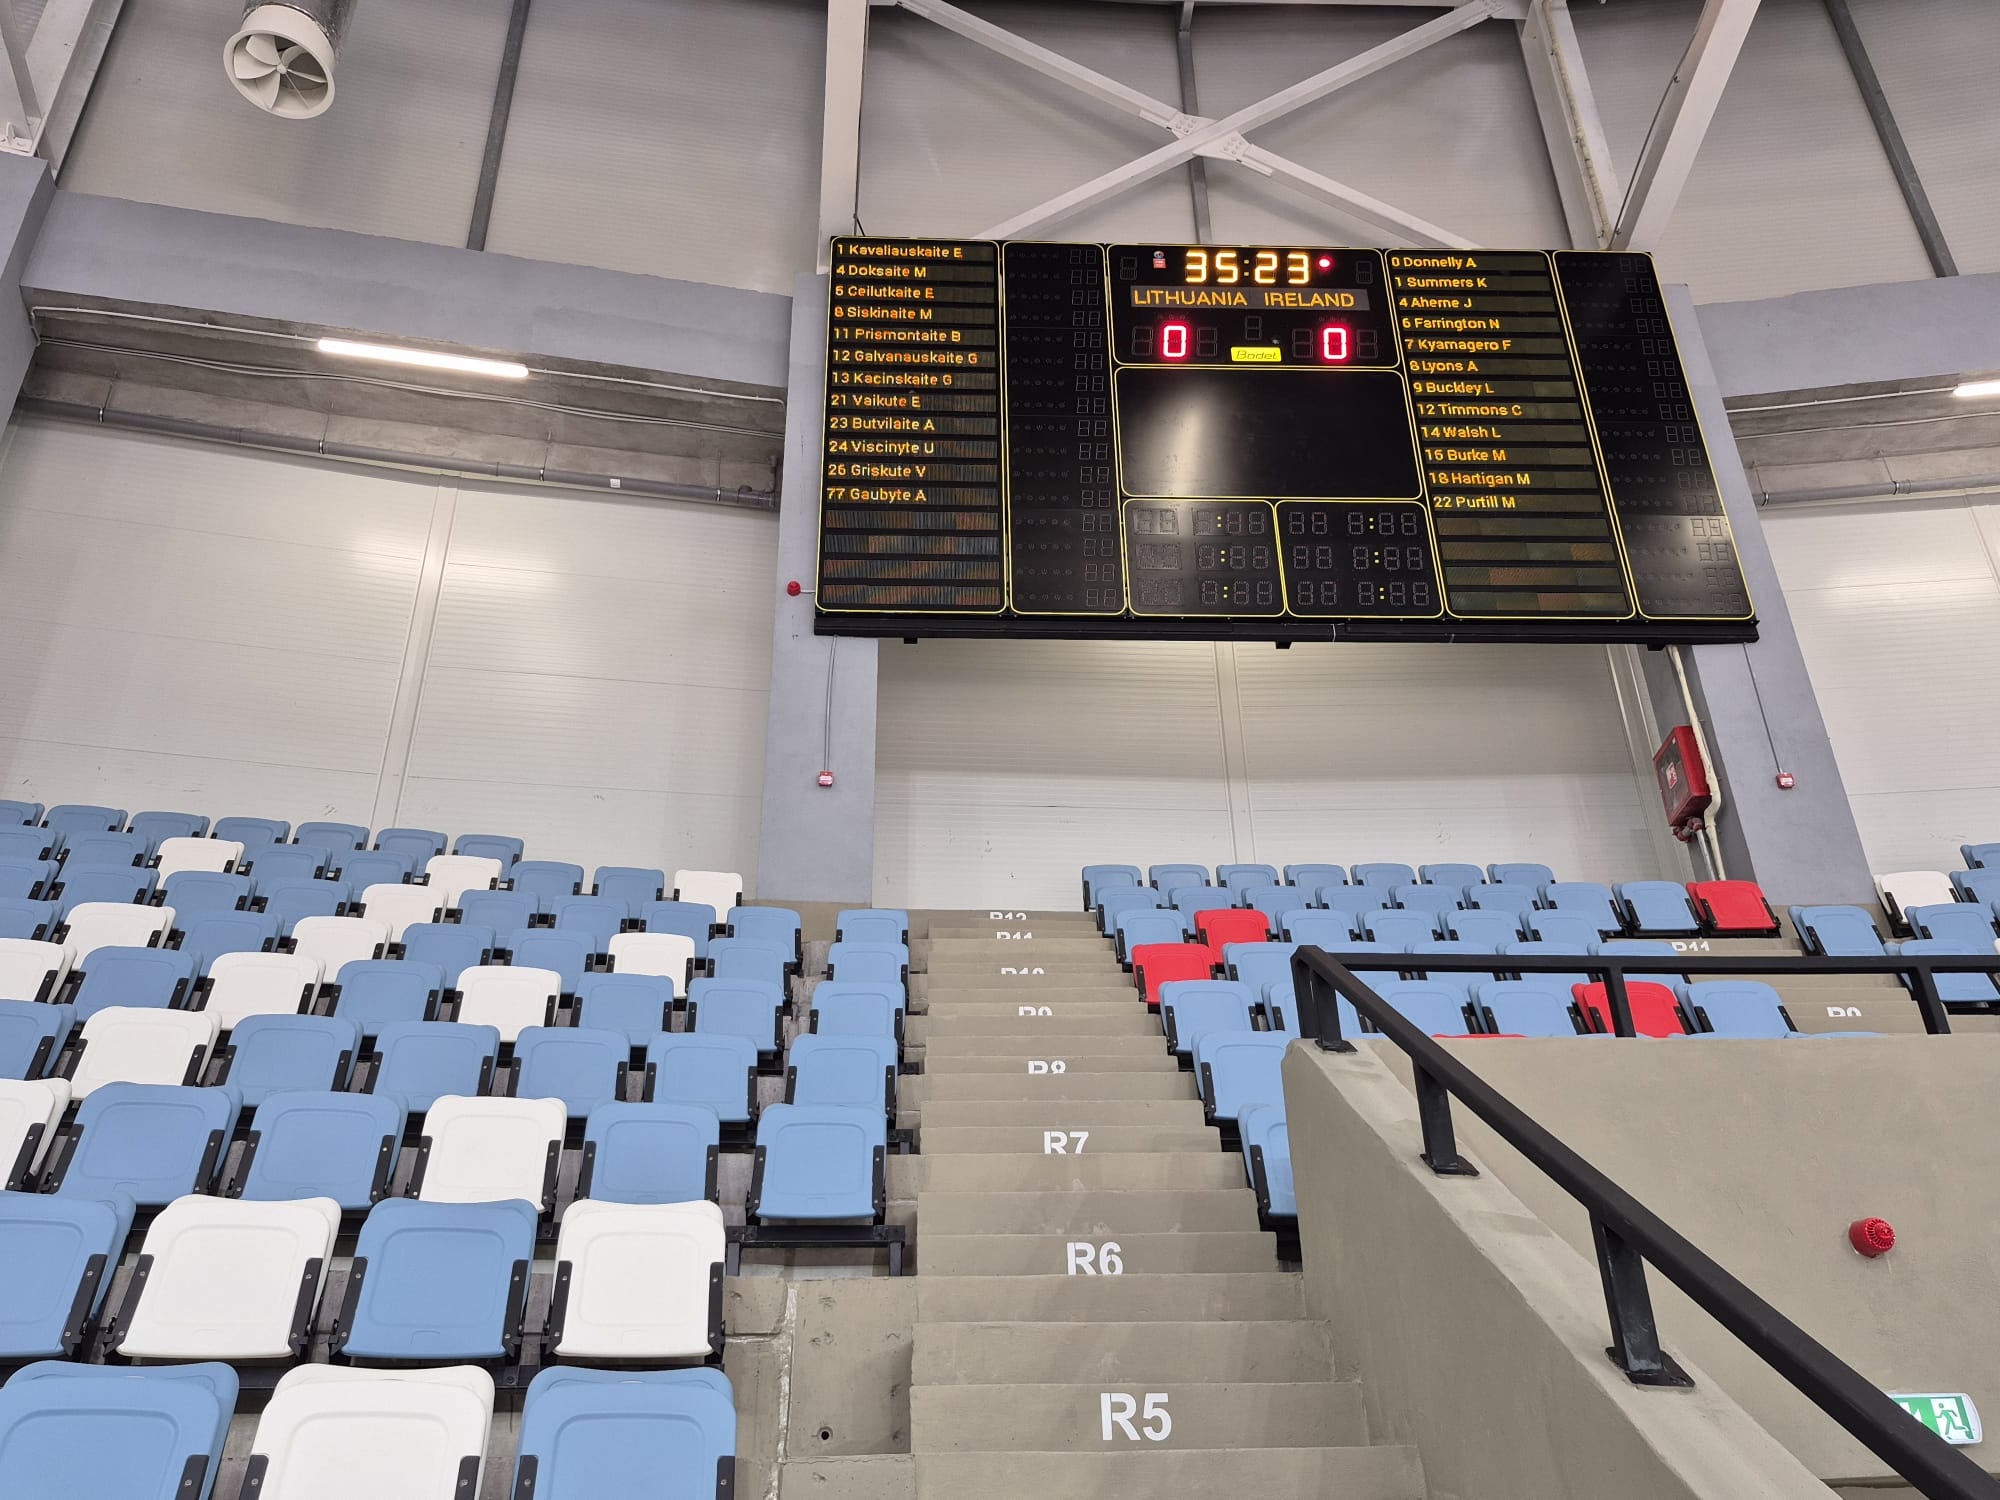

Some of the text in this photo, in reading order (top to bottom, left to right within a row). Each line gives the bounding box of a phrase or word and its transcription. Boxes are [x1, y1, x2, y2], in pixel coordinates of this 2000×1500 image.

[838, 245, 963, 259] 1 Kavaliauskaite E
[1185, 251, 1309, 284] 35:23
[1392, 257, 1477, 270] 0 Donnelly A
[837, 265, 927, 278] 4 Doksaite M
[1395, 277, 1488, 288] 1 Summers K
[848, 286, 921, 299] Ceilutkaite
[926, 288, 935, 299] E
[1134, 290, 1355, 307] LITHUANIA IRELAND
[1399, 297, 1473, 308] 4 Aherne J
[835, 307, 932, 320] 8 Siskinaite M
[1403, 318, 1500, 332] 6 Farrington N
[834, 328, 961, 343] 11 Prismontaite B
[1163, 325, 1187, 358] 0
[1323, 327, 1347, 360] 0
[1406, 339, 1512, 353] 7 Kyamagero F
[834, 350, 978, 365] 12 Galvanauskaite G
[1236, 350, 1277, 360] Bodet
[1410, 361, 1479, 375] 8 Lyons A
[834, 372, 952, 386] 13 Kacinskaite G
[1413, 382, 1495, 397] 9 Buckley L
[832, 395, 921, 408] 21 Vaikute E
[1417, 403, 1523, 416] 12 Timmons C
[831, 417, 935, 431] 23 Butvilaite A
[1422, 427, 1502, 439] 14 Walsh L
[830, 441, 934, 455] 24 Viscinyte U
[1447, 449, 1489, 461] Burke
[1493, 450, 1507, 462] M
[829, 464, 926, 478] 26 Griskute V
[1429, 473, 1531, 488] 18 Hartigan M
[827, 488, 927, 503] 77 Gaubyte A
[1435, 496, 1516, 509] 22 Purtill M
[1043, 1130, 1089, 1154] R7
[1066, 1241, 1124, 1275] R6
[1100, 1392, 1172, 1441] R5
